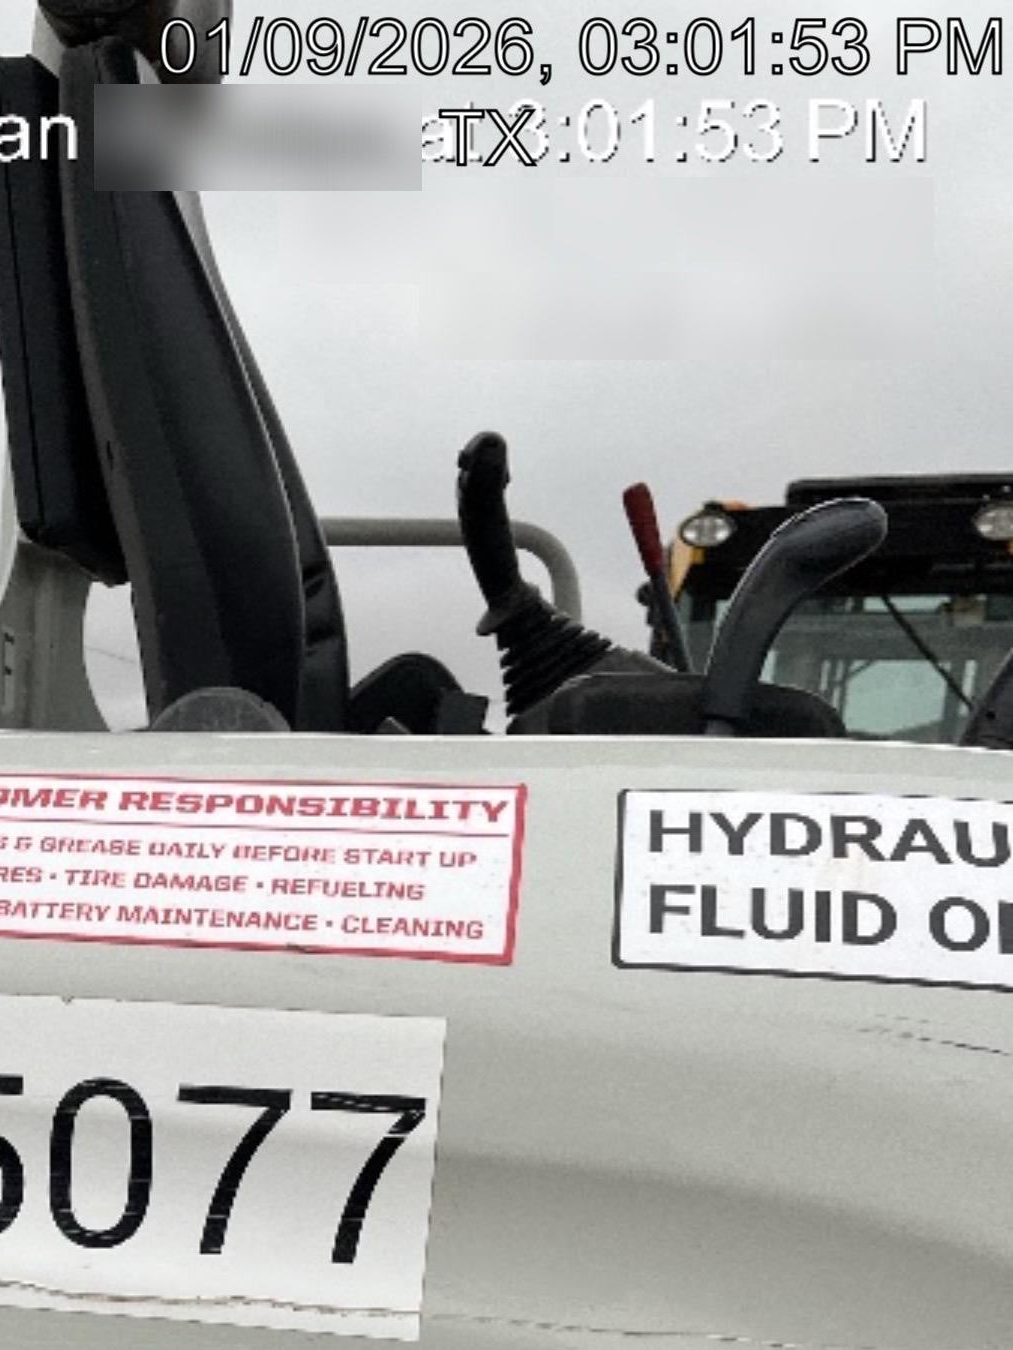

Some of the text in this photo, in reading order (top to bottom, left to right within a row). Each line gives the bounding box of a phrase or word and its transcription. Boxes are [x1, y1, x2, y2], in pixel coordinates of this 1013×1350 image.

[118, 790, 508, 822] RESPONSIBILITY
[40, 838, 141, 856] GREASE
[148, 842, 225, 860] DAILY
[233, 845, 336, 865] BEFORE
[343, 849, 431, 868] START
[439, 852, 477, 868] UP
[649, 810, 1011, 867] HYDRAU
[65, 869, 125, 887] TIRE
[134, 872, 249, 892] DAMAGE
[271, 878, 424, 900] REFUELING
[117, 904, 318, 931] MAINTENANCE
[341, 916, 485, 939] CLEANING
[649, 884, 897, 945] FLUID
